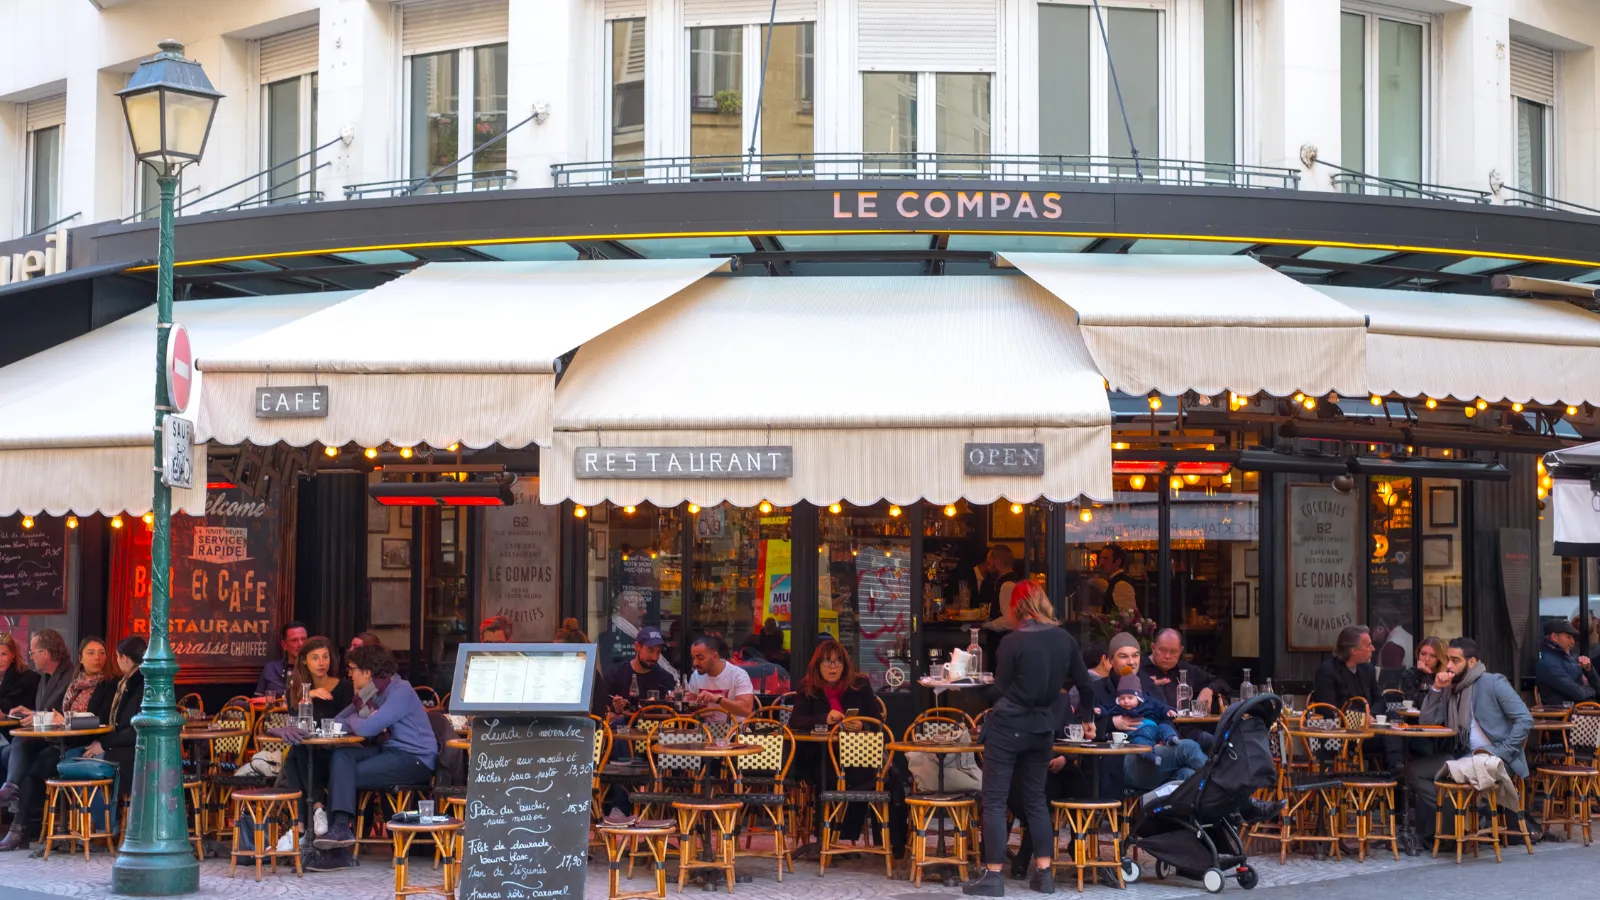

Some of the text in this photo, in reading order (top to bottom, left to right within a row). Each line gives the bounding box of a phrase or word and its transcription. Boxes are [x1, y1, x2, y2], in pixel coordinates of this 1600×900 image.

[833, 191, 1063, 219] LE COMPAS
[261, 392, 321, 412] CAFE
[172, 421, 190, 440] SAUF
[584, 452, 782, 473] RESTAURANT
[969, 447, 1040, 466] OPEN
[204, 492, 264, 518] elcome
[1301, 500, 1346, 518] COCKTAILS
[512, 516, 529, 528] 62
[1316, 522, 1332, 534] 62
[198, 536, 242, 544] SERVICE
[198, 546, 242, 556] RAPIDE
[489, 566, 552, 583] LE COMPAS
[1295, 572, 1307, 588] LE
[1311, 572, 1353, 588] COMPAS
[192, 568, 208, 600] Et
[218, 569, 266, 612] CAFE
[133, 619, 270, 634] RSTAURANT
[1297, 612, 1352, 631] CHAMPAGNES
[169, 641, 228, 655] errasse
[481, 719, 520, 740] Lundi
[526, 720, 538, 738] 6
[476, 752, 512, 771] Risotto
[517, 757, 533, 766] aux
[566, 751, 578, 762] et
[535, 767, 558, 784] pesto
[468, 838, 489, 856] Filet
[493, 840, 506, 850] de
[494, 867, 504, 877] de
[532, 886, 571, 898] caramel
